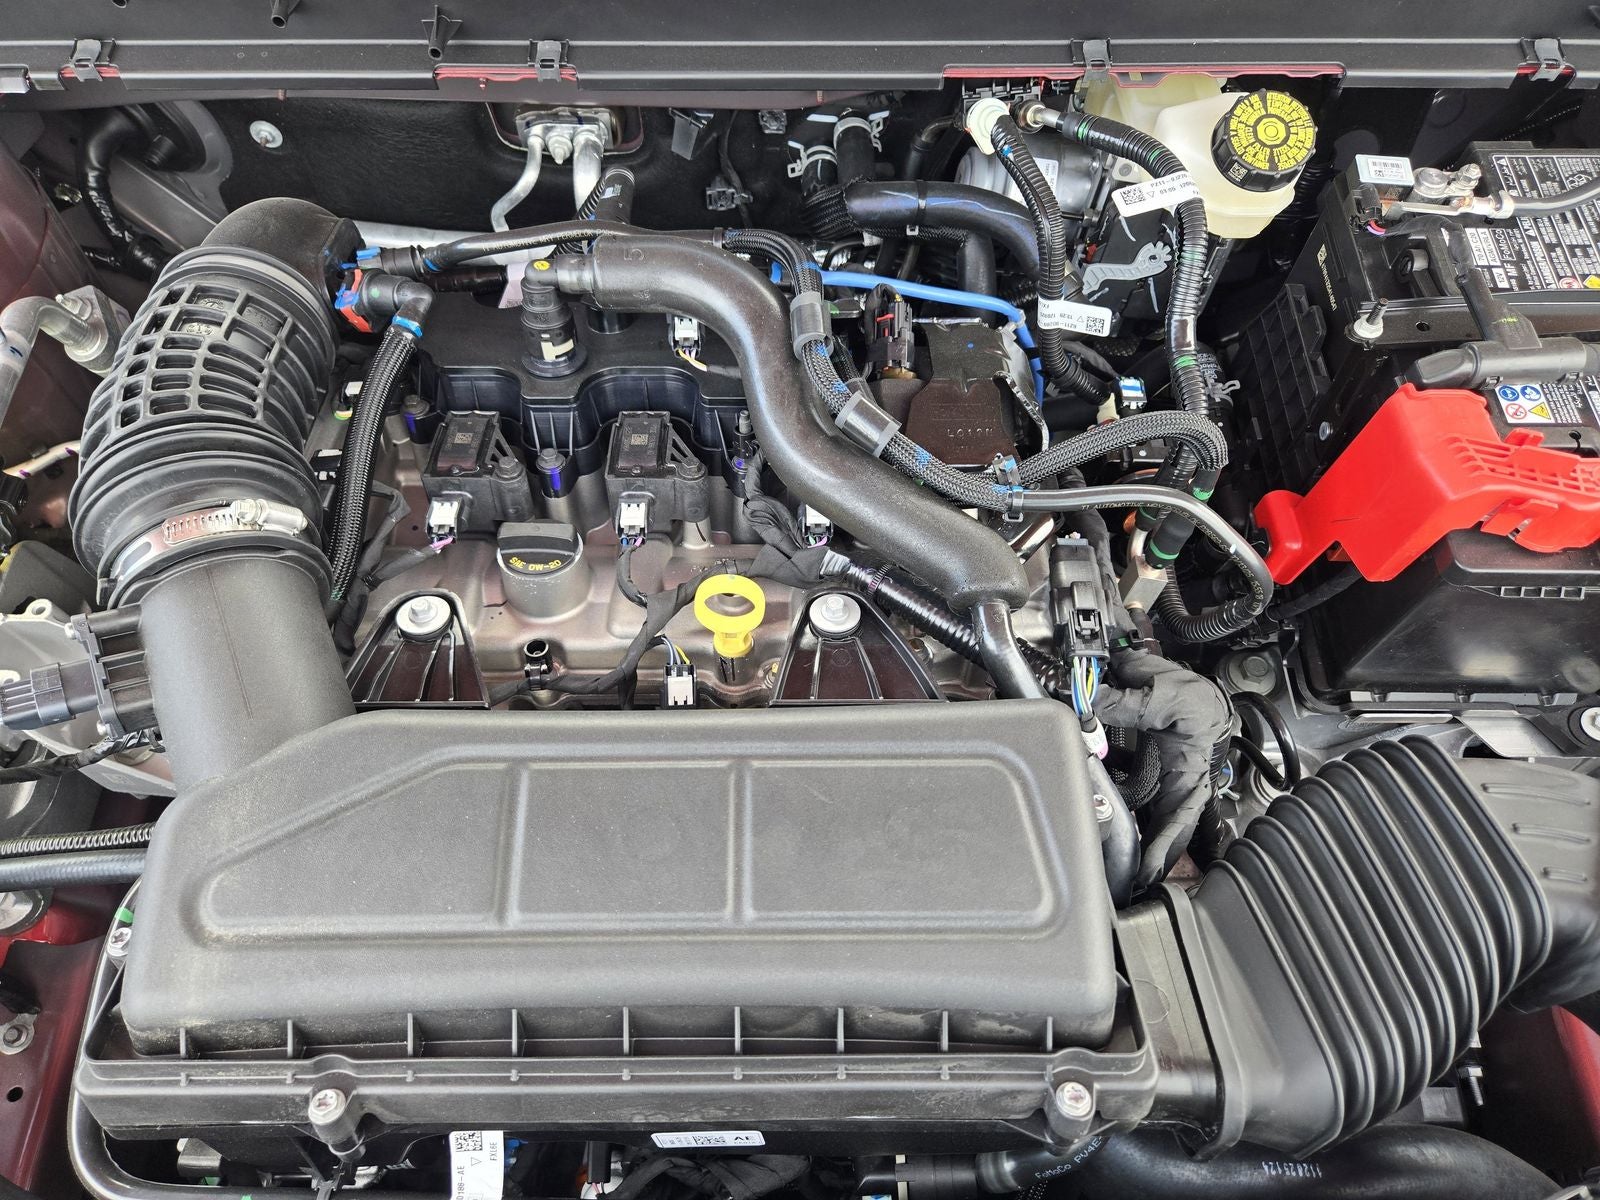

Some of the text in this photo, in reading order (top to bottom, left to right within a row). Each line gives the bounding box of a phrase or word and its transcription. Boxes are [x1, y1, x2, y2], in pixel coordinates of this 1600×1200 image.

[1495, 228, 1511, 260] FoMoCo
[509, 556, 562, 571] SAE 0W-20
